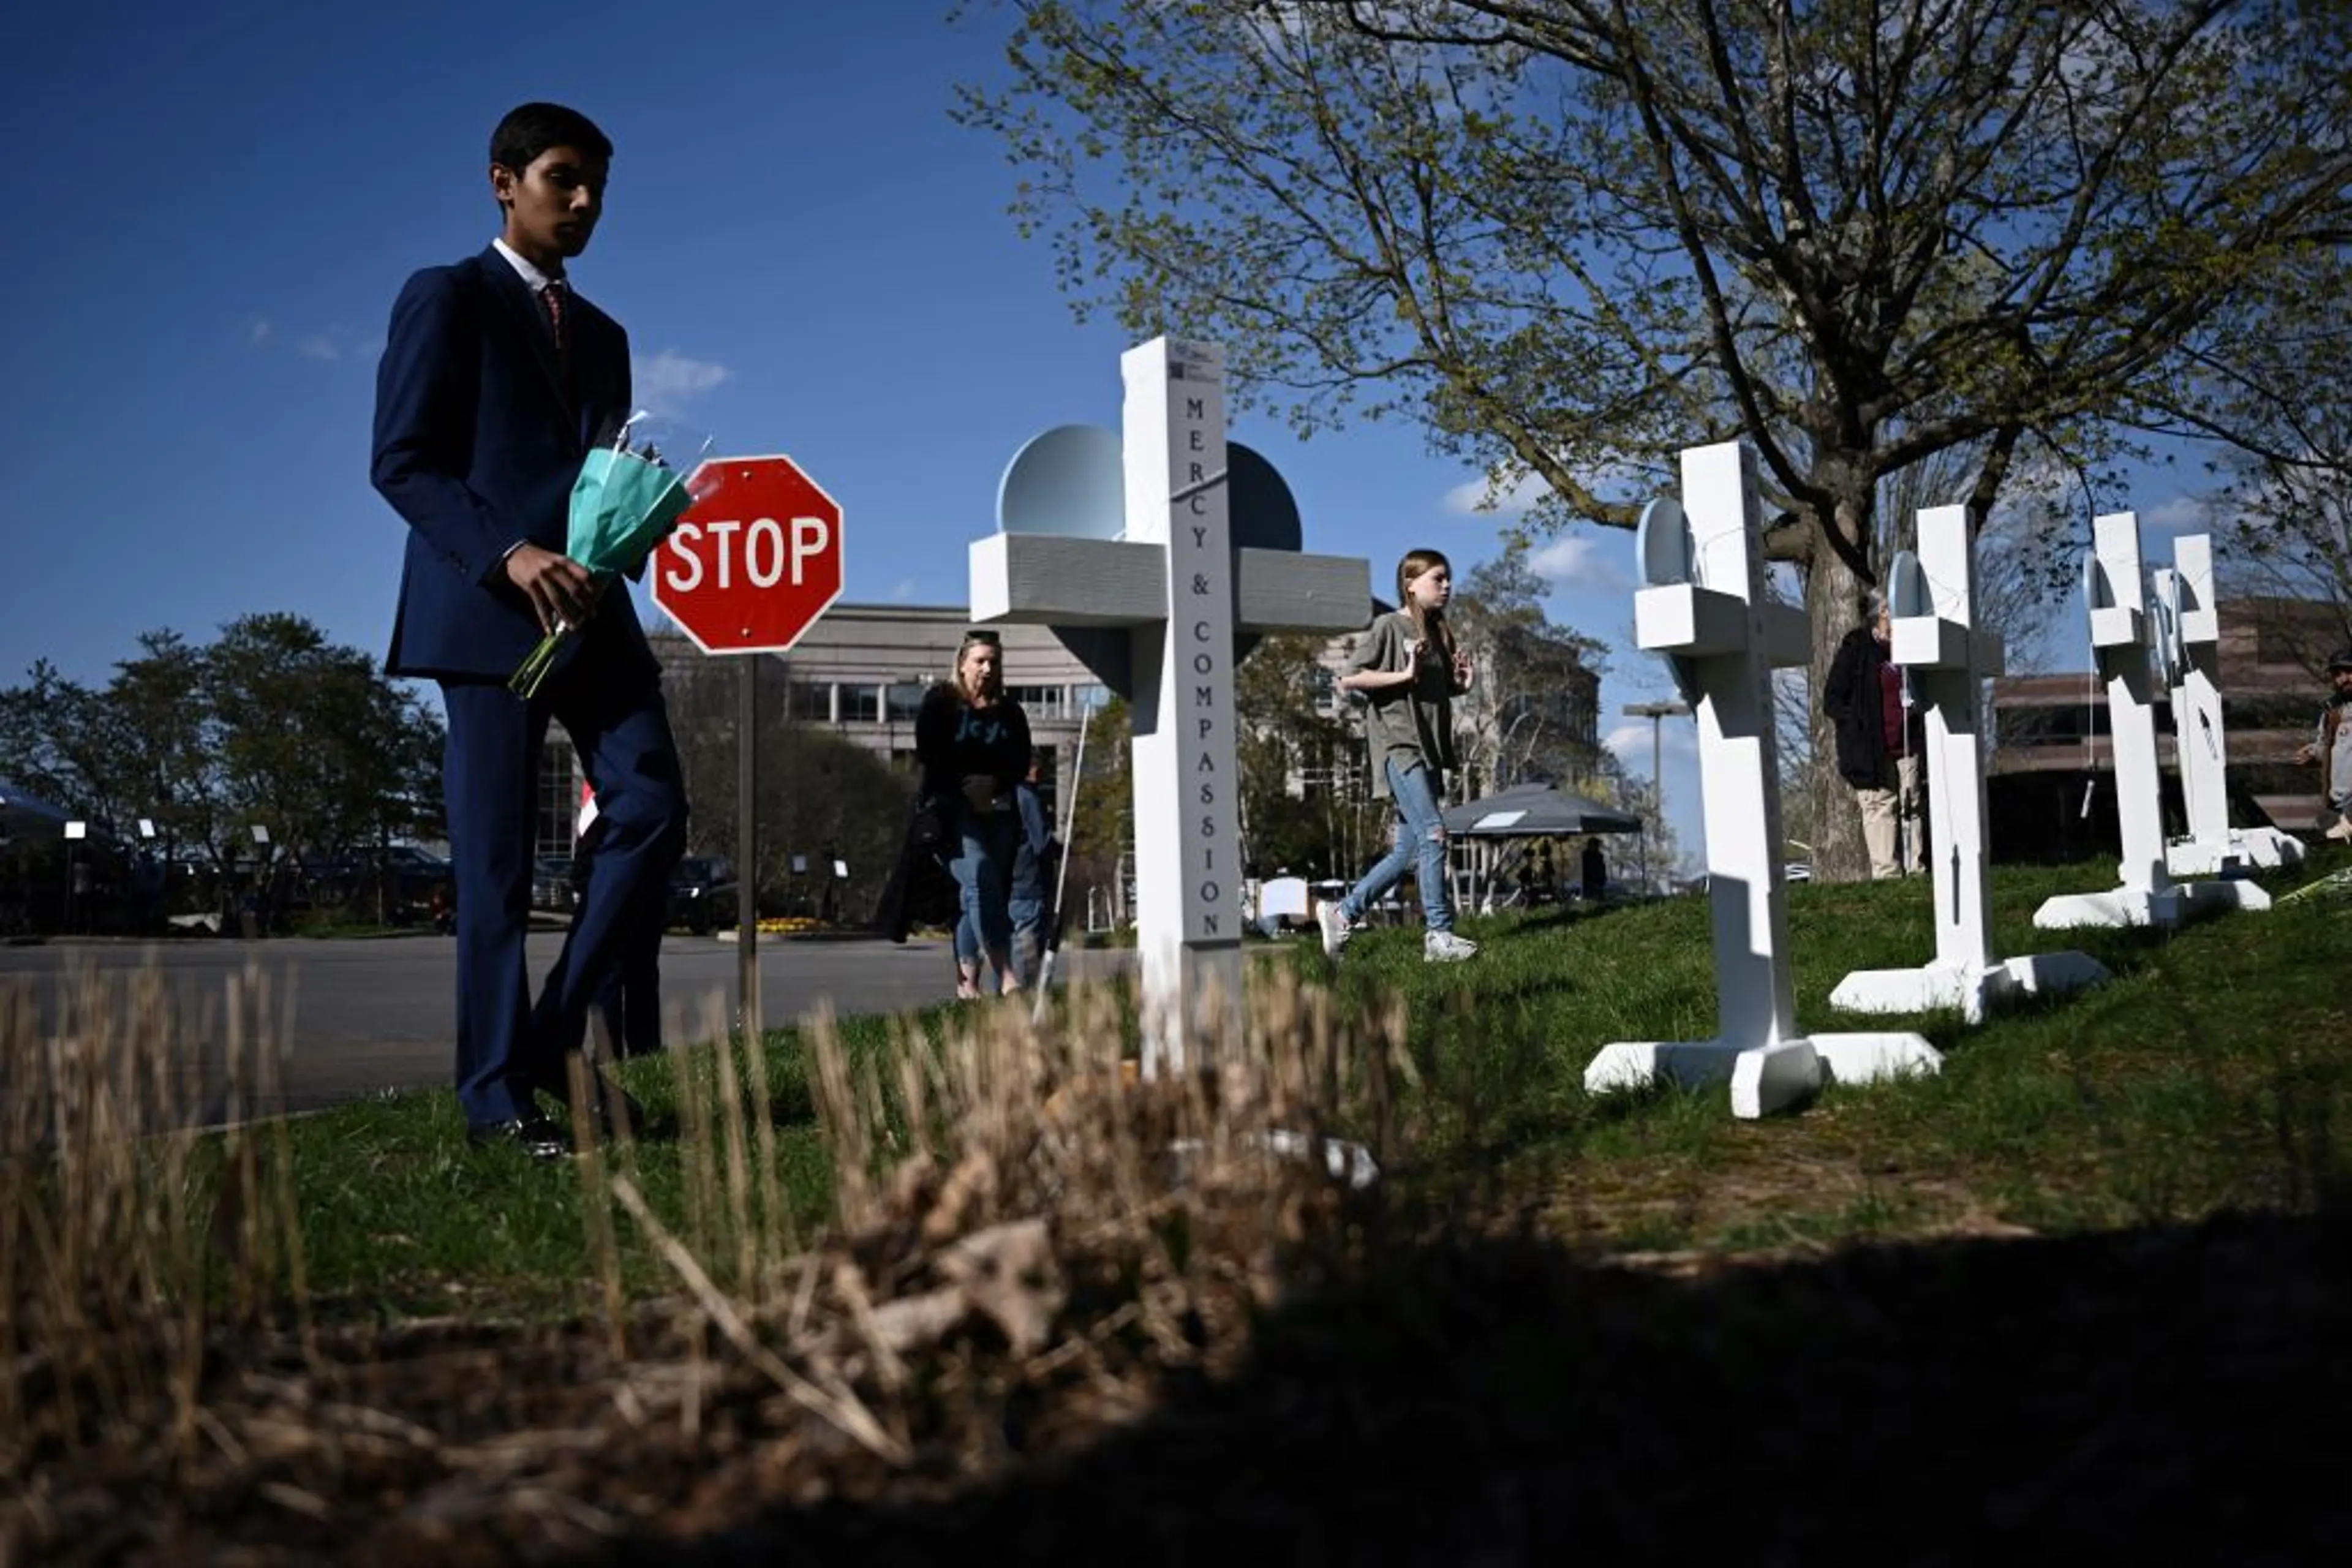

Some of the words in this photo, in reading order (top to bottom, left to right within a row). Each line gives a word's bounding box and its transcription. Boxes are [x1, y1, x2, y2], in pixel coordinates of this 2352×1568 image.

[1187, 398, 1207, 549] MERCY
[666, 517, 829, 592] STOP
[1192, 573, 1209, 595] &
[1194, 621, 1219, 935] COMPASSION
